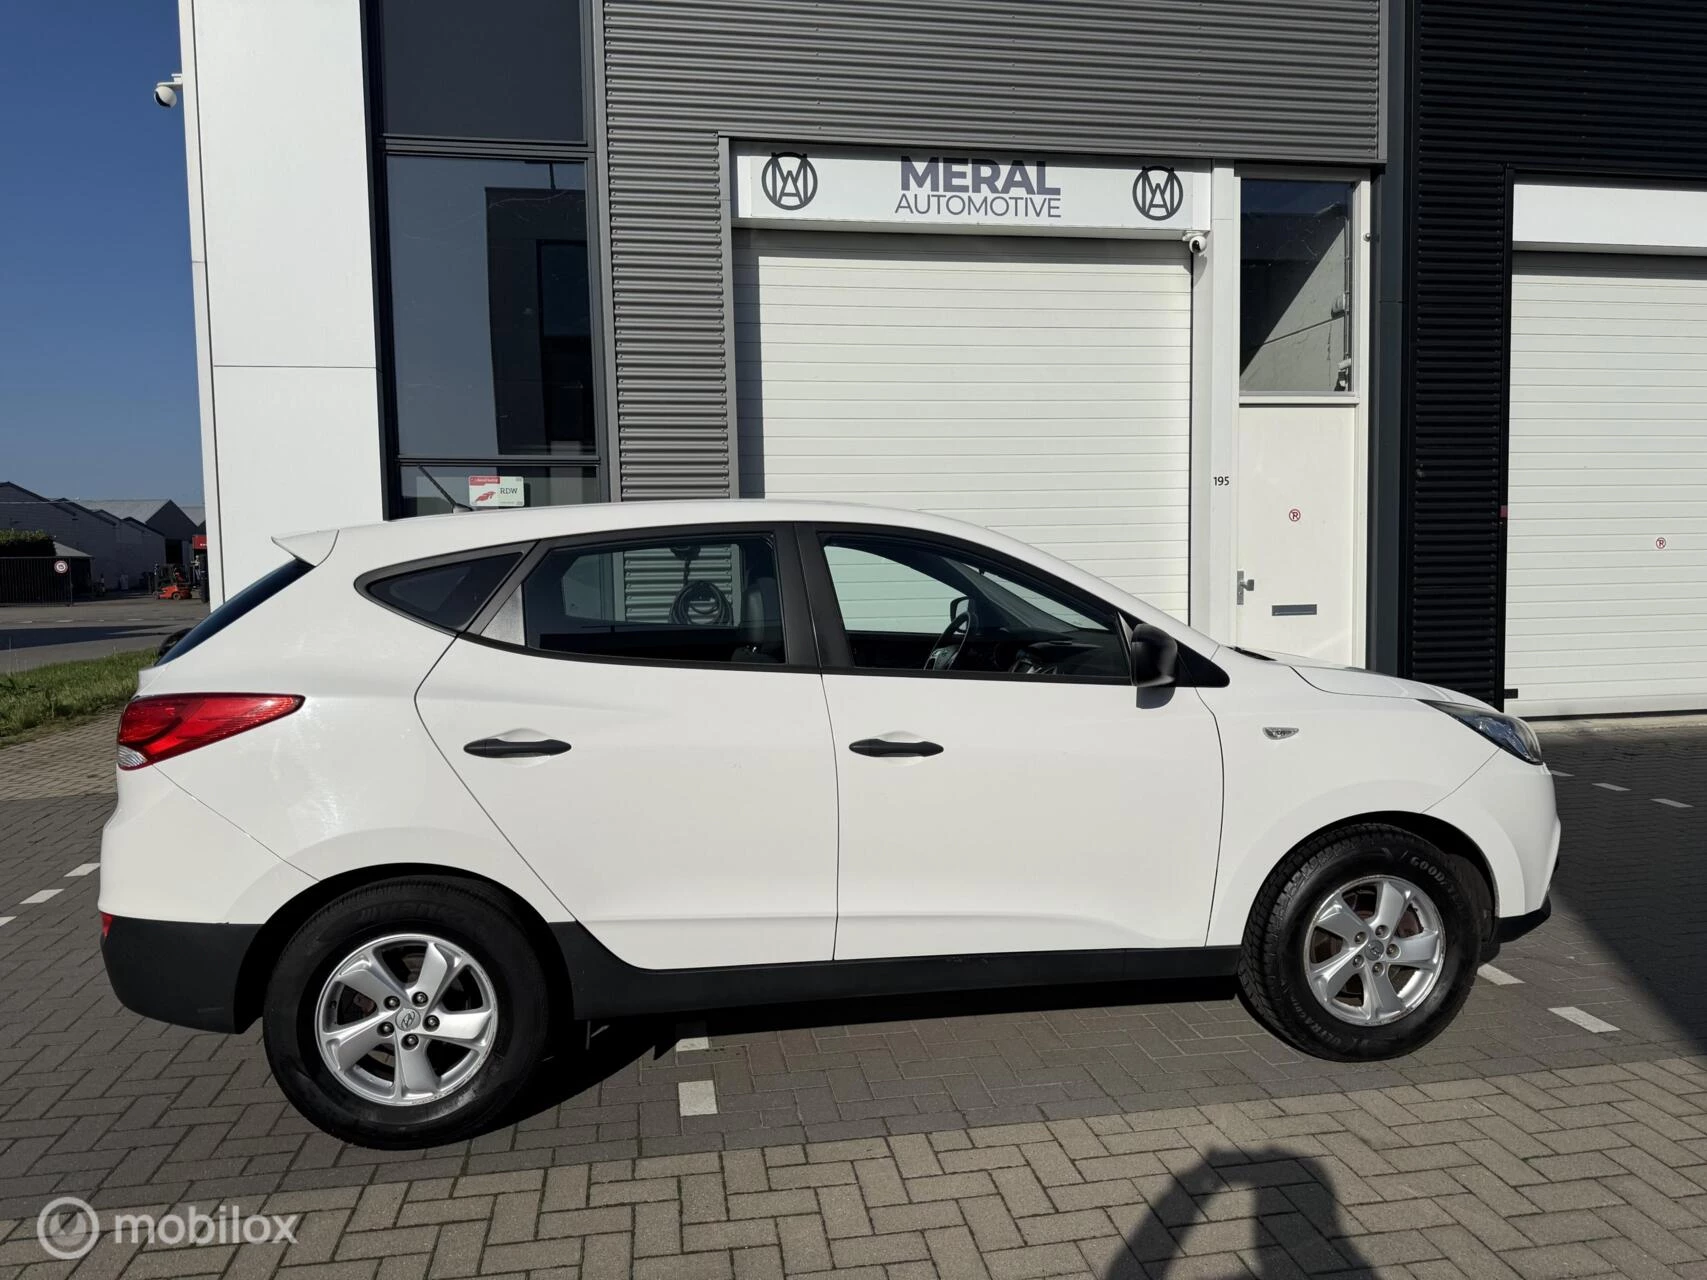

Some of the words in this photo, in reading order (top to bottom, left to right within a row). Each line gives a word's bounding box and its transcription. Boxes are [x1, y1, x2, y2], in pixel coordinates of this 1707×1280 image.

[900, 155, 1061, 196] MERAL
[895, 193, 1061, 218] AUTOMOTIVE
[1213, 476, 1230, 486] 195
[500, 487, 518, 495] RDW
